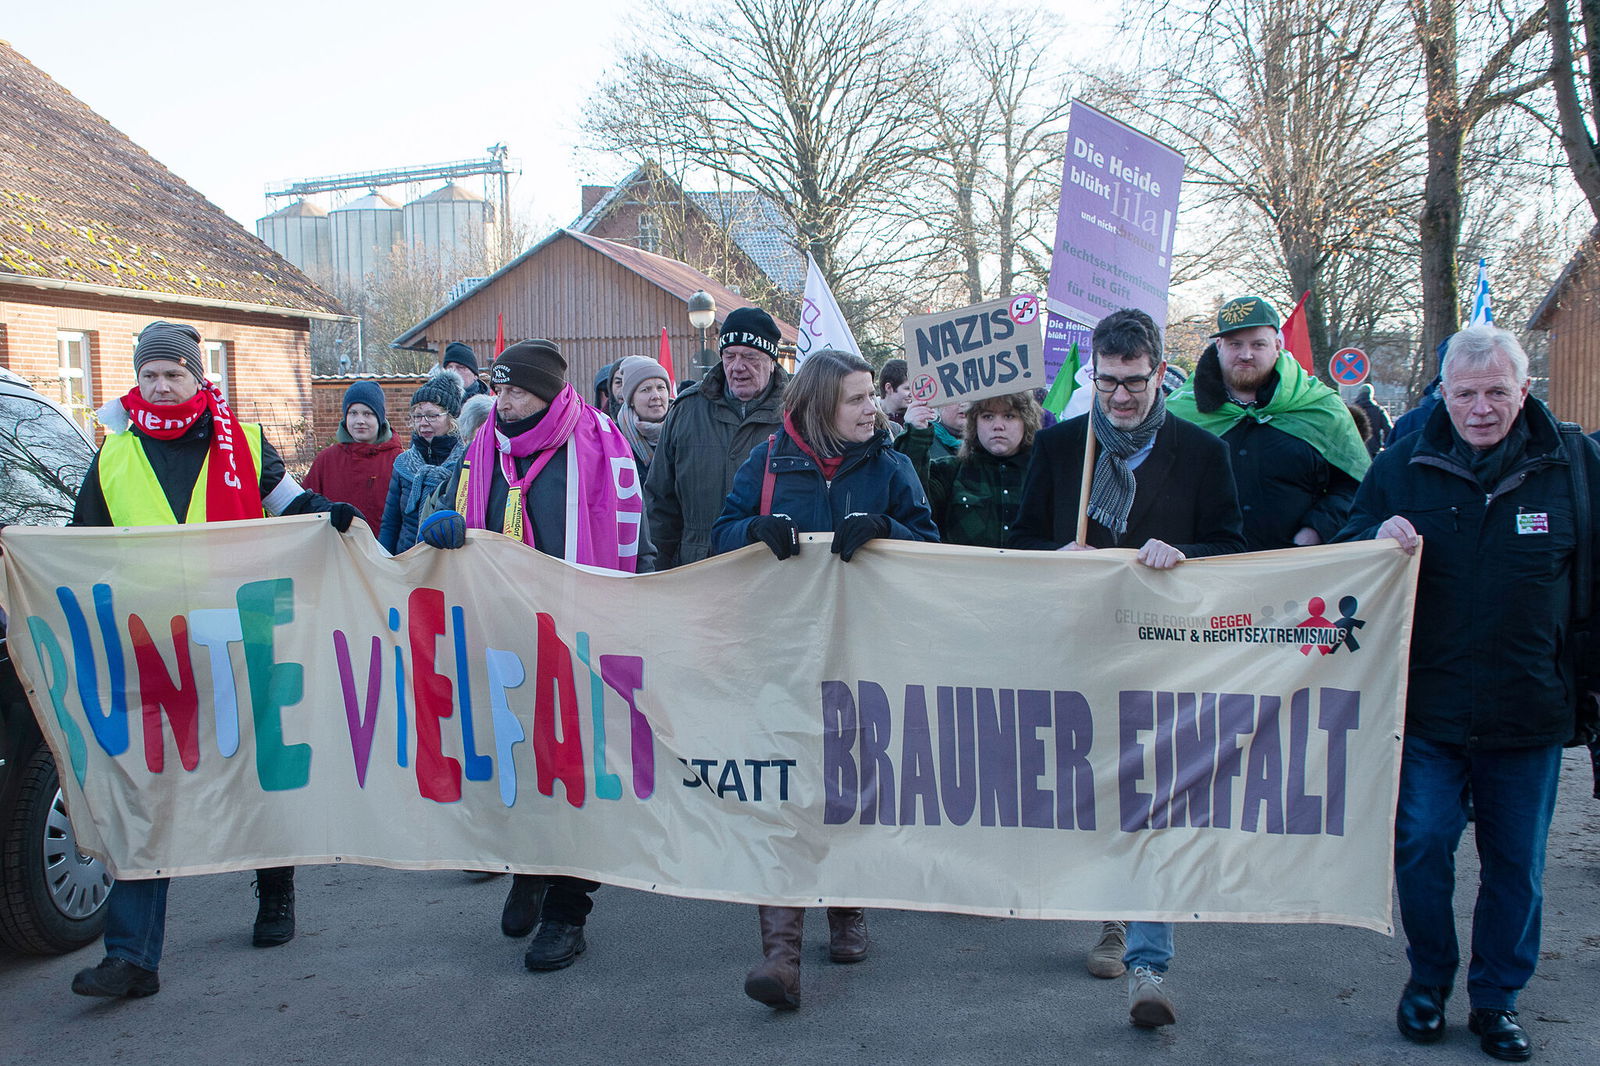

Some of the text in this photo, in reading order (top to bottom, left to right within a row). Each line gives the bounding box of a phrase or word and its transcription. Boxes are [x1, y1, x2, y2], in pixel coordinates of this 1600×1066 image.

[1070, 166, 1111, 200] blüht
[1073, 137, 1161, 198] Die Heide
[1081, 211, 1096, 225] und
[1097, 219, 1118, 234] nicht
[1062, 240, 1168, 301] Rechtsextremismus
[1092, 272, 1131, 301] ist Gift
[1067, 280, 1123, 313] für unser
[915, 308, 1015, 367] NAZIS
[1048, 319, 1064, 329] Die
[936, 344, 1032, 398] RAUS!
[1115, 609, 1252, 630] CELLER FORUM GEGEN
[1138, 627, 1348, 646] GEWALT & RECHTSEXTREMISMUS
[821, 679, 1097, 831] BRAUNER
[1118, 687, 1361, 837] EINFALT
